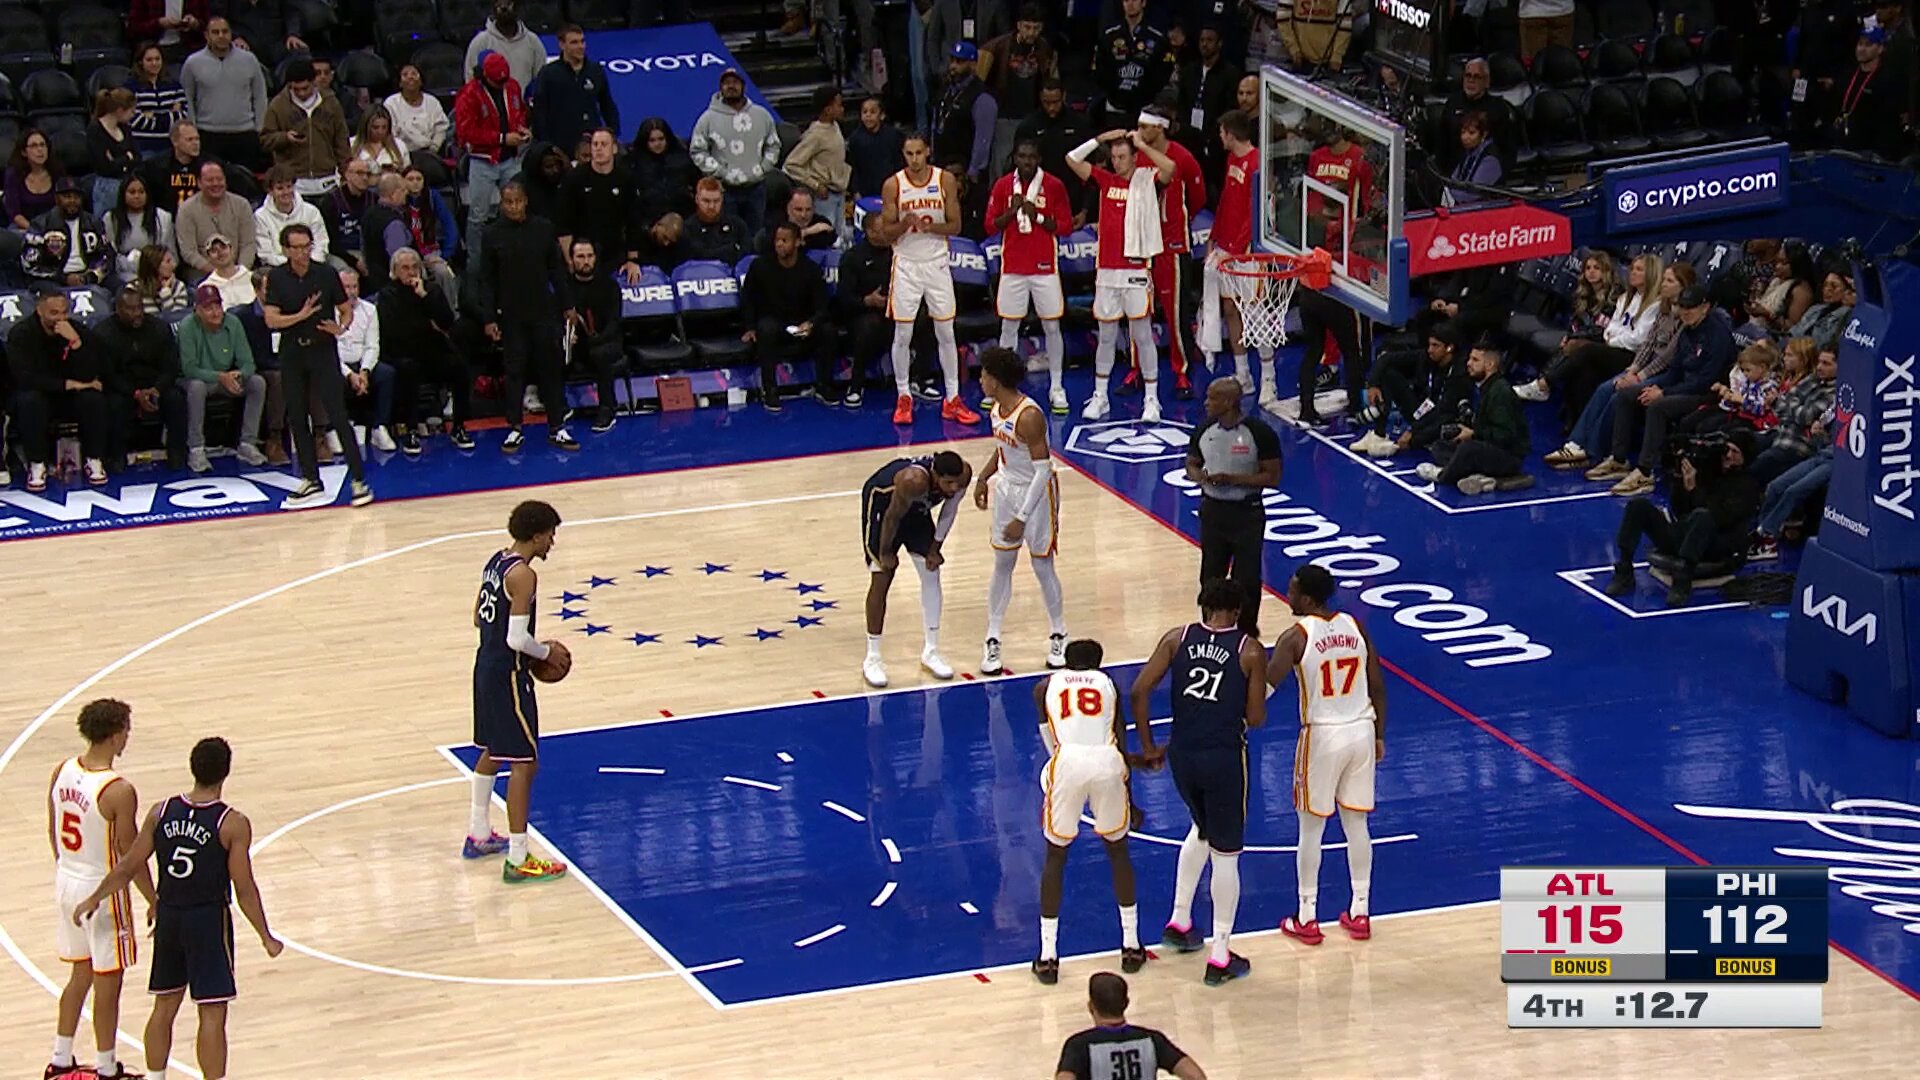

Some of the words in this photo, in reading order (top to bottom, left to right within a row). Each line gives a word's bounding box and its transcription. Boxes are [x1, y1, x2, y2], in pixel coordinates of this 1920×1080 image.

[1389, 0, 1431, 28] TISSOT
[901, 199, 944, 211] ATLANTA
[1645, 171, 1777, 207] crypto.com
[948, 251, 987, 270] URE
[622, 285, 674, 302] PURE
[677, 278, 738, 297] PURE
[1873, 354, 1920, 520] xfinity
[0, 465, 349, 529] way
[77, 518, 111, 529] Call
[115, 506, 248, 524] 1-800-Gambler
[479, 588, 498, 623] 25
[1187, 643, 1230, 665] EMBIID
[1183, 667, 1224, 702] 21
[1320, 656, 1360, 697] 17
[1059, 687, 1102, 720] 18
[61, 811, 83, 852] 5
[163, 820, 212, 846] GRIMES
[168, 846, 197, 879] 5
[1110, 1049, 1143, 1080] 36
